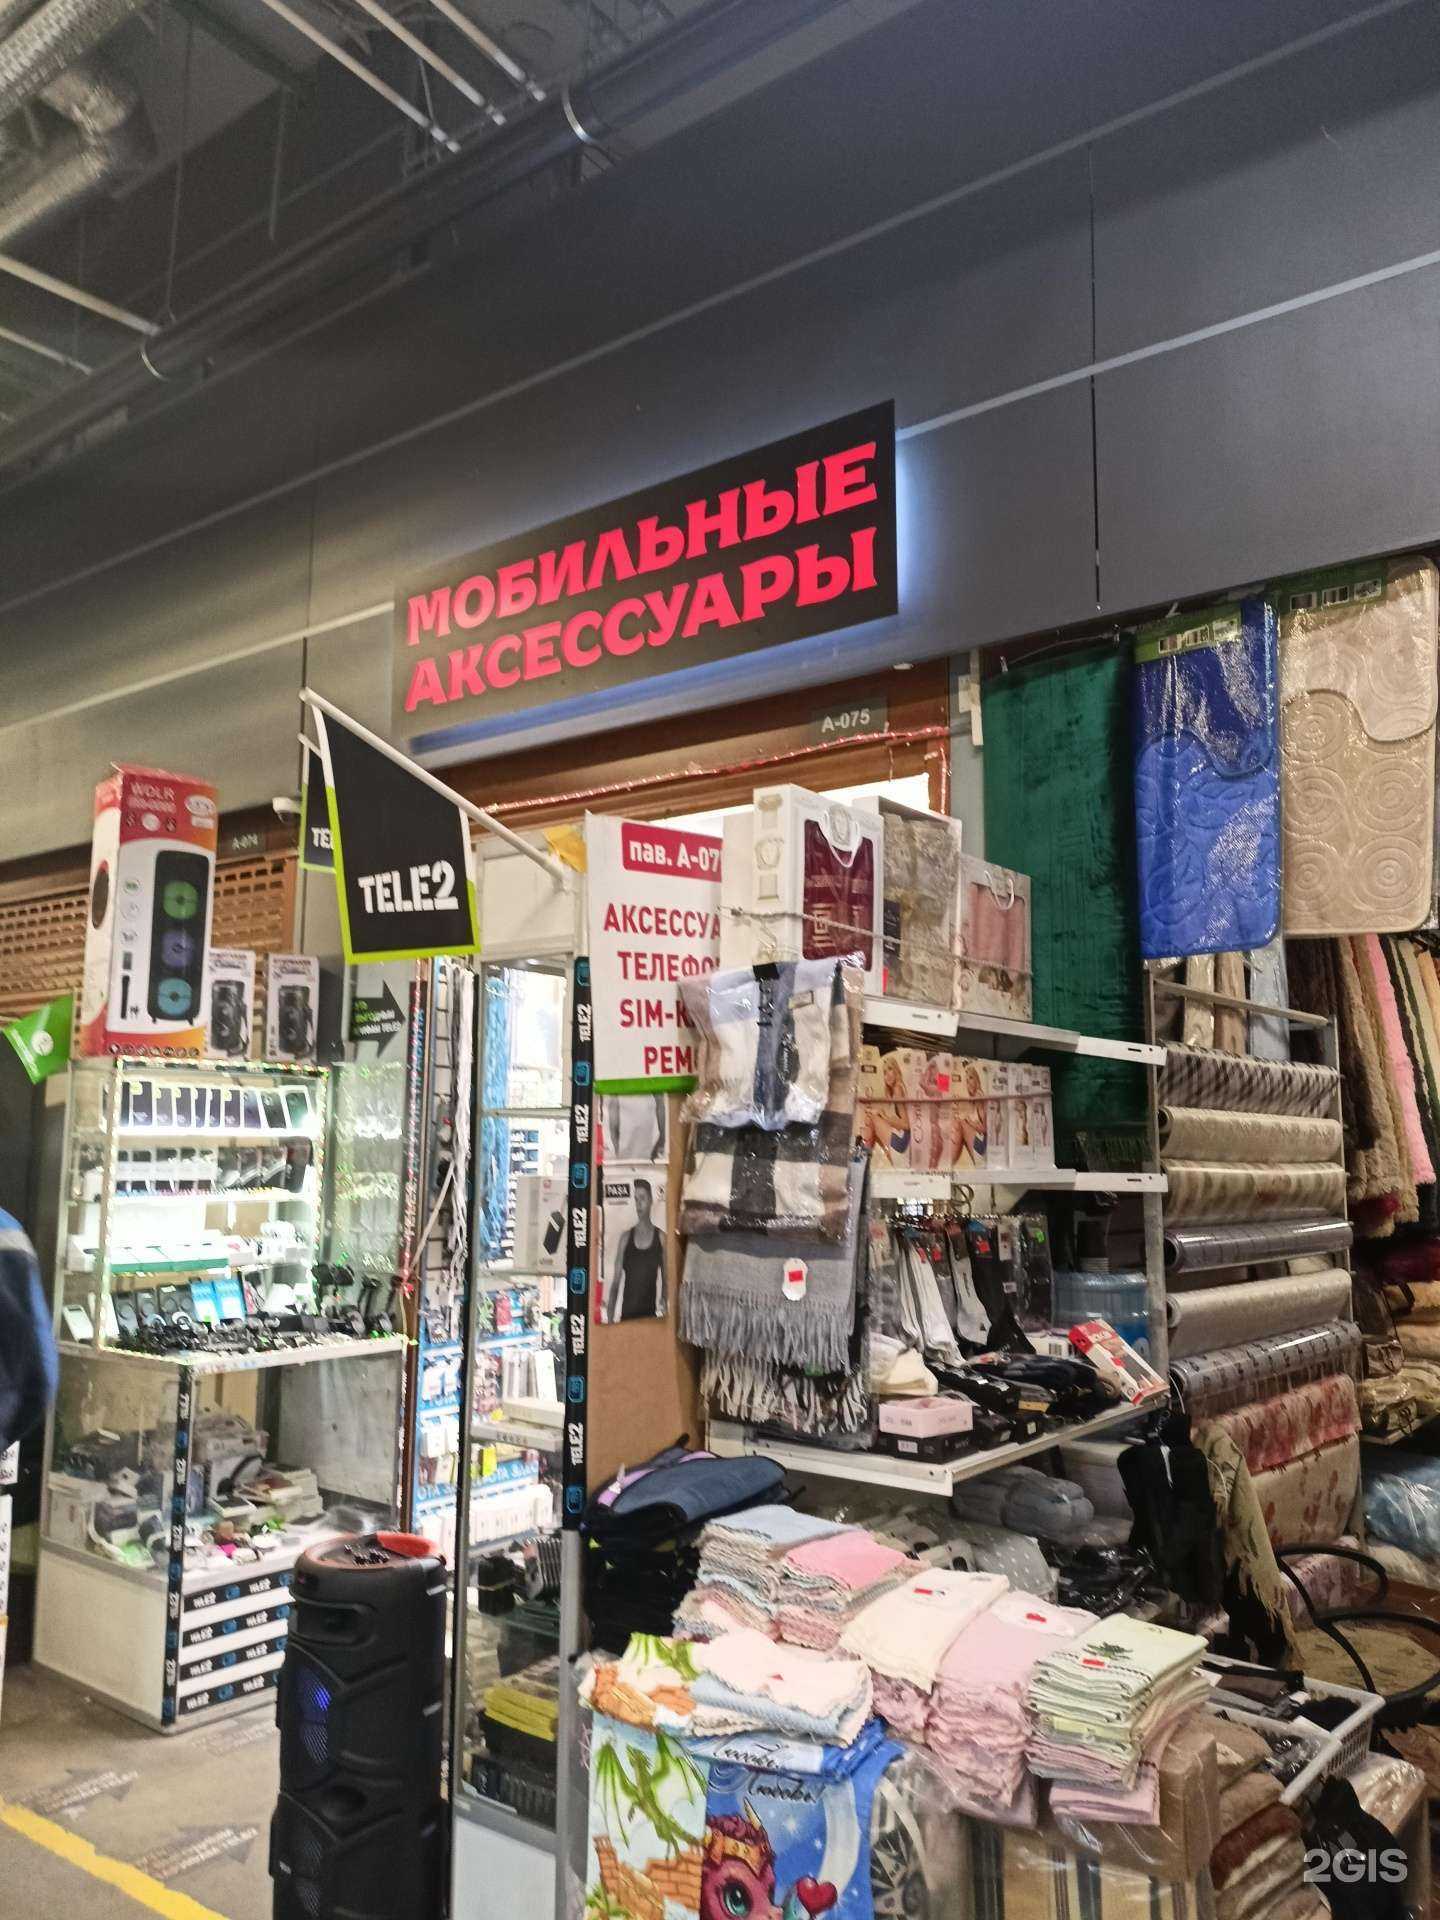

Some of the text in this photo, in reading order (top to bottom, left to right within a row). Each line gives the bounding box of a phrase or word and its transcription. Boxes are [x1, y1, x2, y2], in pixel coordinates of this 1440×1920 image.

[407, 441, 878, 646] МОБИЛЬНЫЕ
[404, 526, 878, 713] АКСЕССУАРЫ
[311, 827, 334, 849] TE
[629, 839, 673, 866] пав.
[358, 860, 459, 913] TELE2
[617, 951, 720, 982] ТЕЛЕФО
[620, 998, 696, 1028] SIM-К
[643, 1045, 698, 1075] РЕМ
